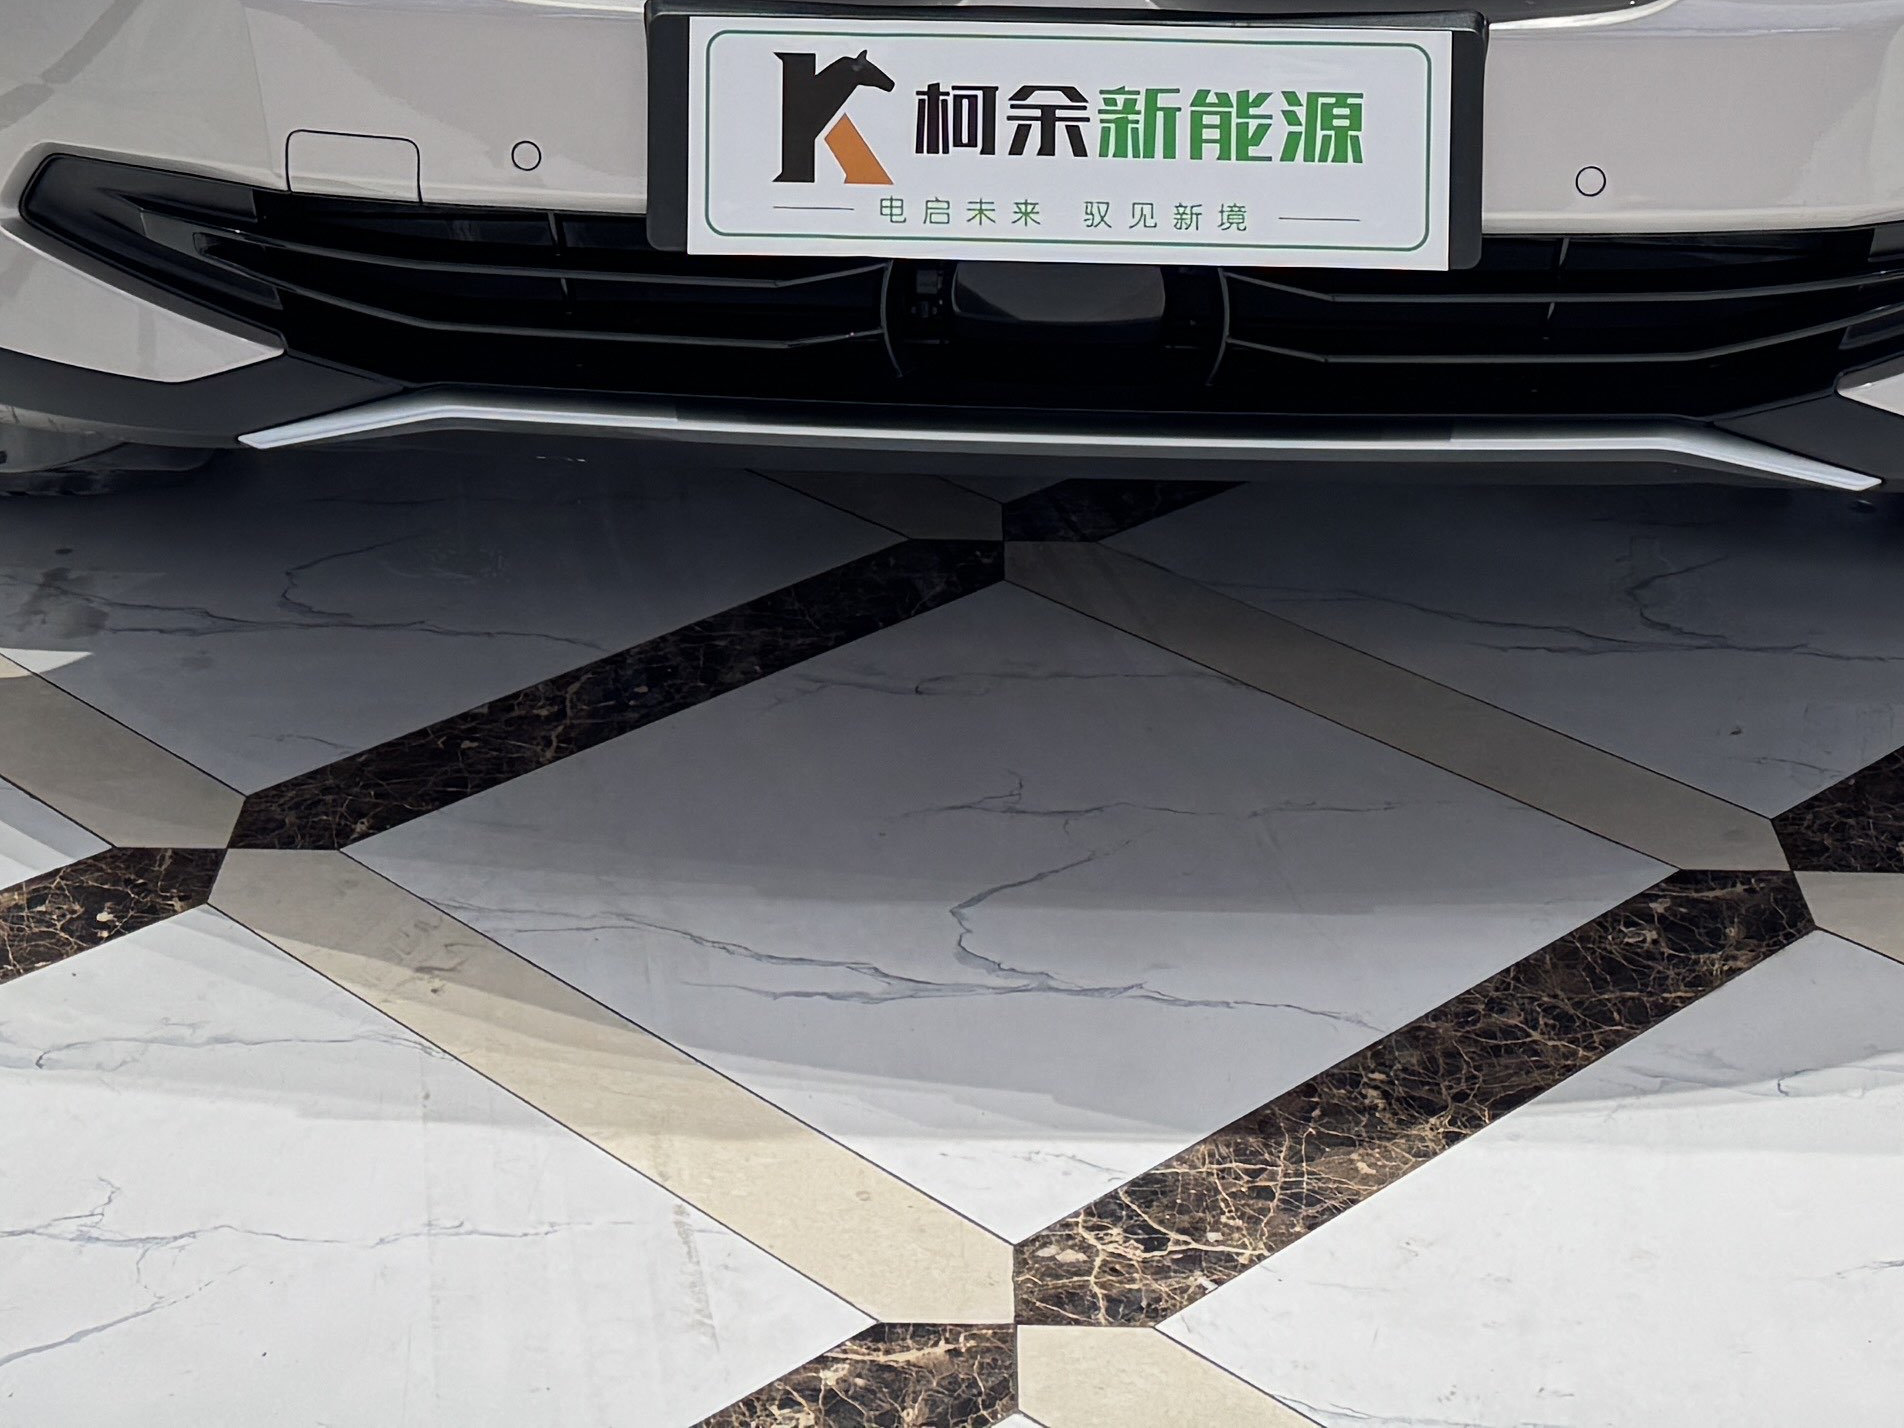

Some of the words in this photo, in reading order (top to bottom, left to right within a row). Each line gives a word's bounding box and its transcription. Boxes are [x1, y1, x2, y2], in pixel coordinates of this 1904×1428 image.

[914, 82, 1364, 164] 柯余新能源
[879, 195, 1042, 227] 电启未来
[1083, 200, 1248, 232] 驭见新境
